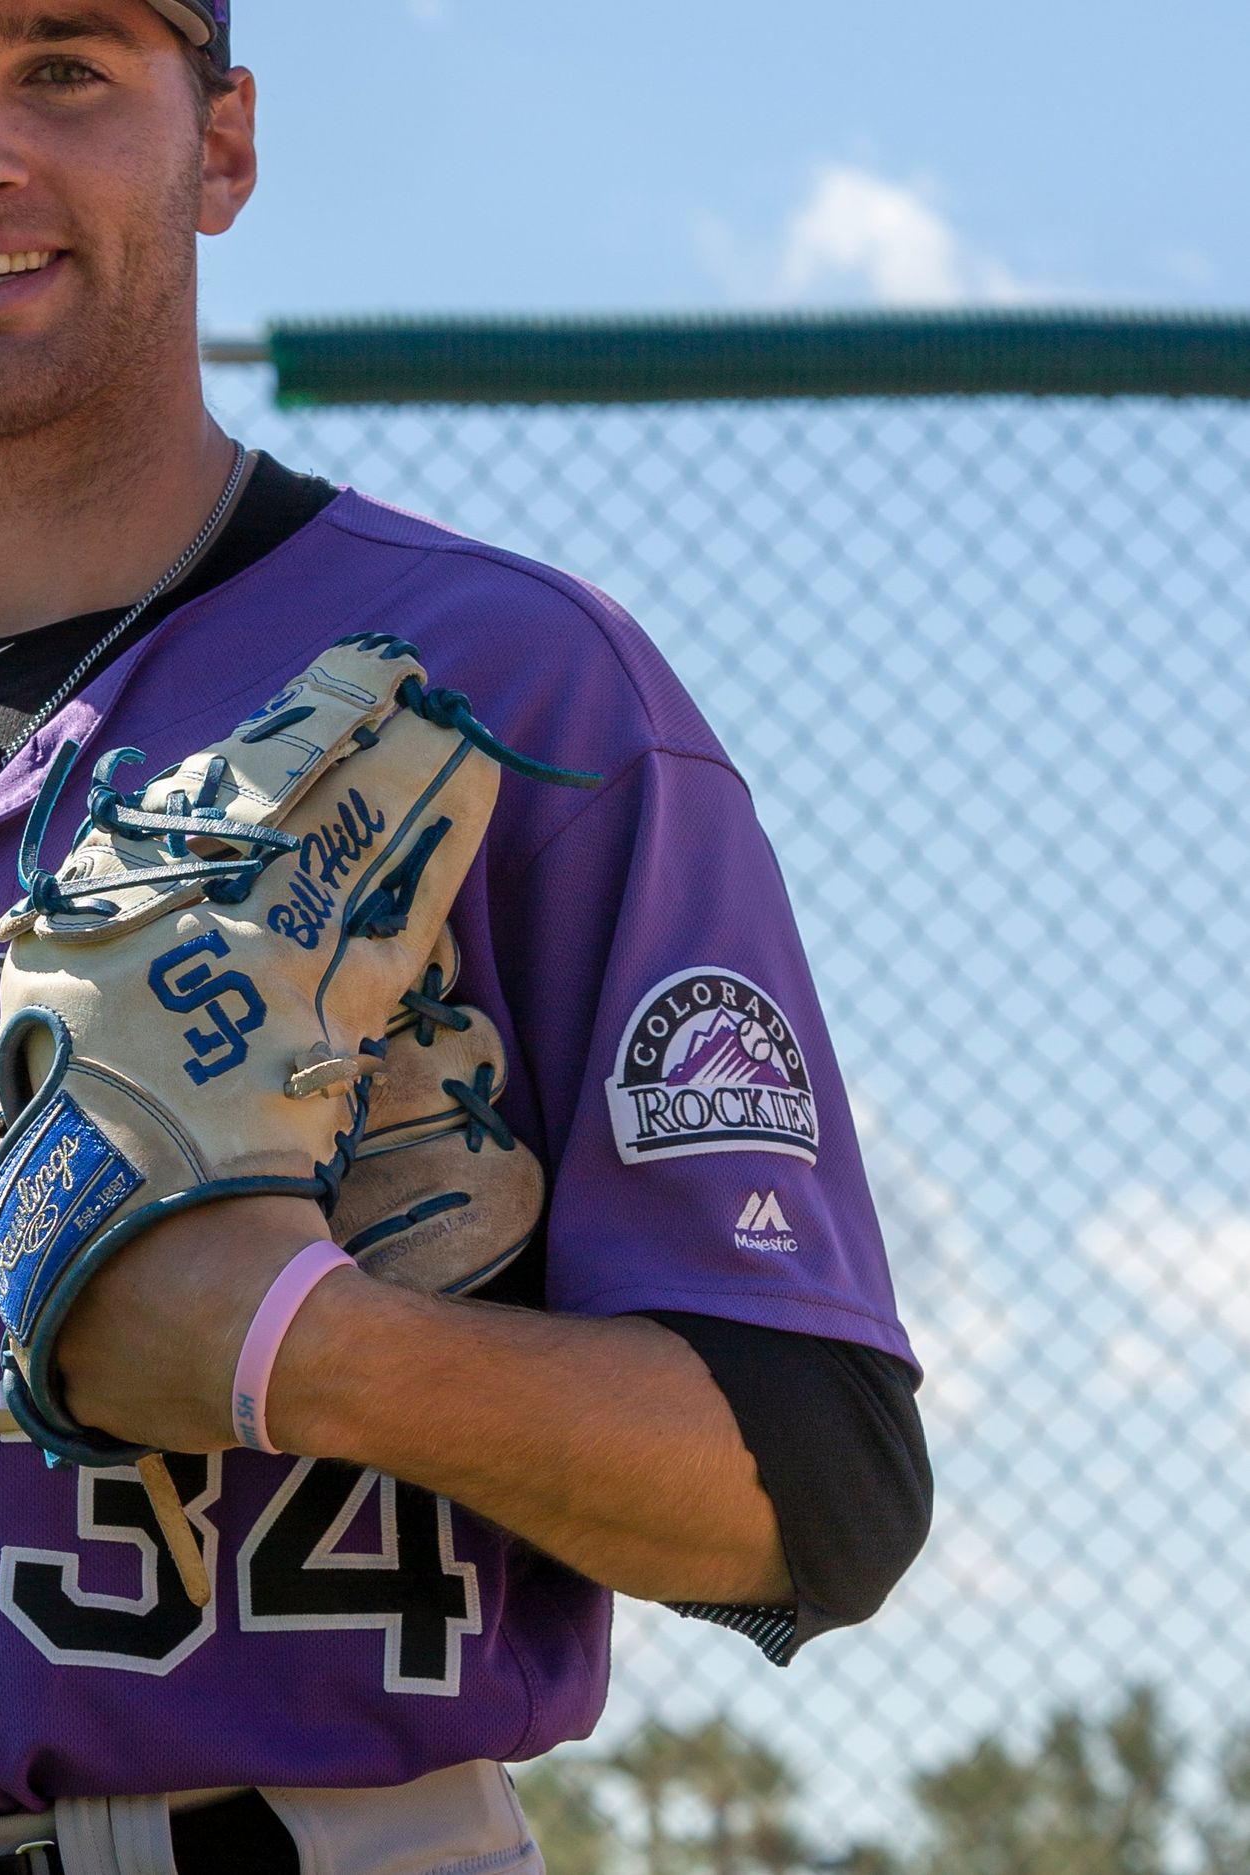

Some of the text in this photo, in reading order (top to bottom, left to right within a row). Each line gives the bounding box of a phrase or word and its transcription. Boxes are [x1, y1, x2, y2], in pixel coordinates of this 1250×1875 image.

[267, 788, 385, 950] Bill Hill
[633, 981, 800, 1069] COLORADO
[628, 1087, 816, 1139] ROCKIES
[72, 1171, 127, 1232] Est. 1887
[733, 1232, 799, 1252] Majestic
